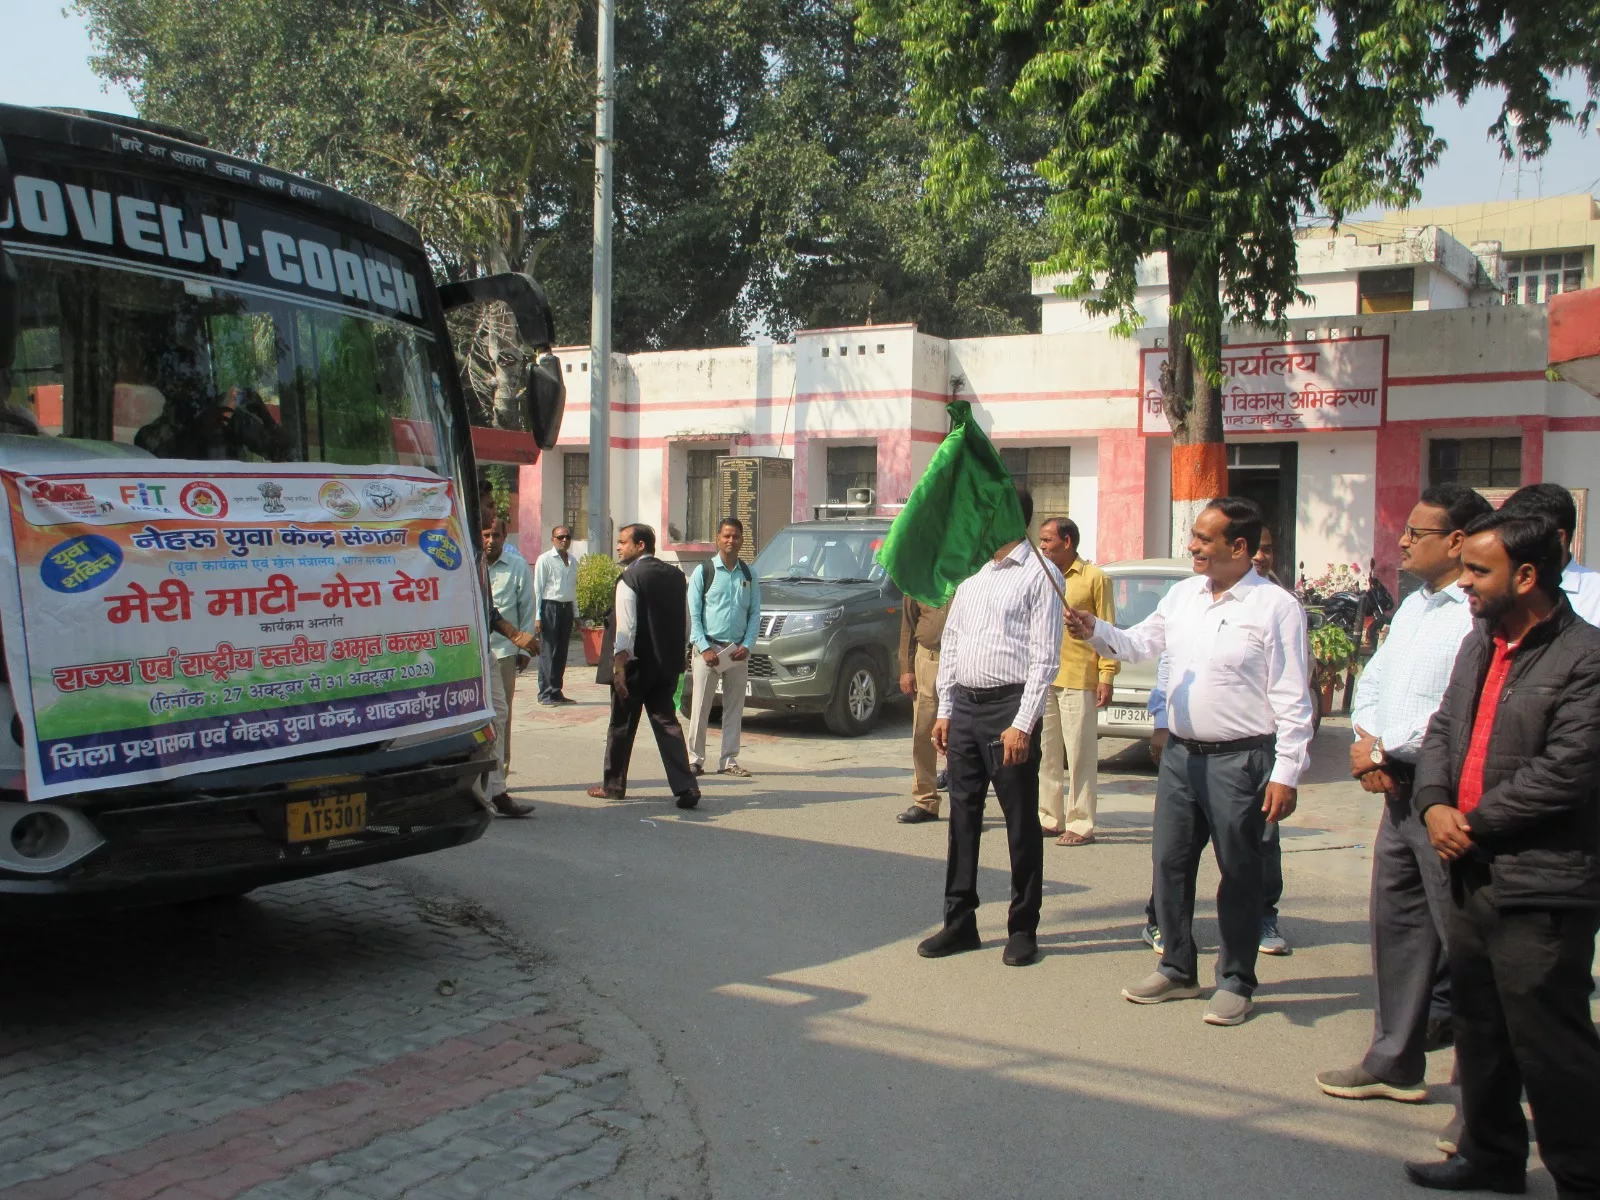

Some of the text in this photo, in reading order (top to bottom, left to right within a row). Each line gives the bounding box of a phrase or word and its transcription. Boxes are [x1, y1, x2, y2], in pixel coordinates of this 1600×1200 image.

[148, 143, 166, 158] का
[171, 151, 207, 168] सहारा
[1230, 386, 1287, 411] विकास
[1288, 383, 1378, 410] अभिकरण
[51, 541, 89, 569] युवा
[132, 526, 408, 557] नेहरू युवा केन्द्र संगठन
[61, 553, 117, 589] शक्ति
[202, 557, 248, 571] कार्यक्रम
[252, 557, 269, 573] एवं
[273, 556, 295, 569] खेल
[104, 578, 194, 624] मेरी
[388, 569, 439, 603] देश
[260, 614, 344, 633] कार्यक्रम अन्तर्गत
[53, 625, 470, 692] राज्य एवं राष्ट्रीय स्तरीय अमृत कलश यात्रा
[224, 688, 243, 703] 27
[250, 680, 304, 700] अक्टूबर
[309, 673, 321, 691] से
[326, 675, 343, 689] 31
[350, 667, 397, 687] अक्टूबर
[50, 742, 116, 771] जिला
[122, 731, 195, 764] प्रशासन
[200, 719, 230, 748] एवं
[232, 718, 279, 743] नेहरू
[284, 715, 315, 741] युवा
[366, 691, 441, 718] शाहजहाँपुर
[304, 804, 363, 835] AT5301
